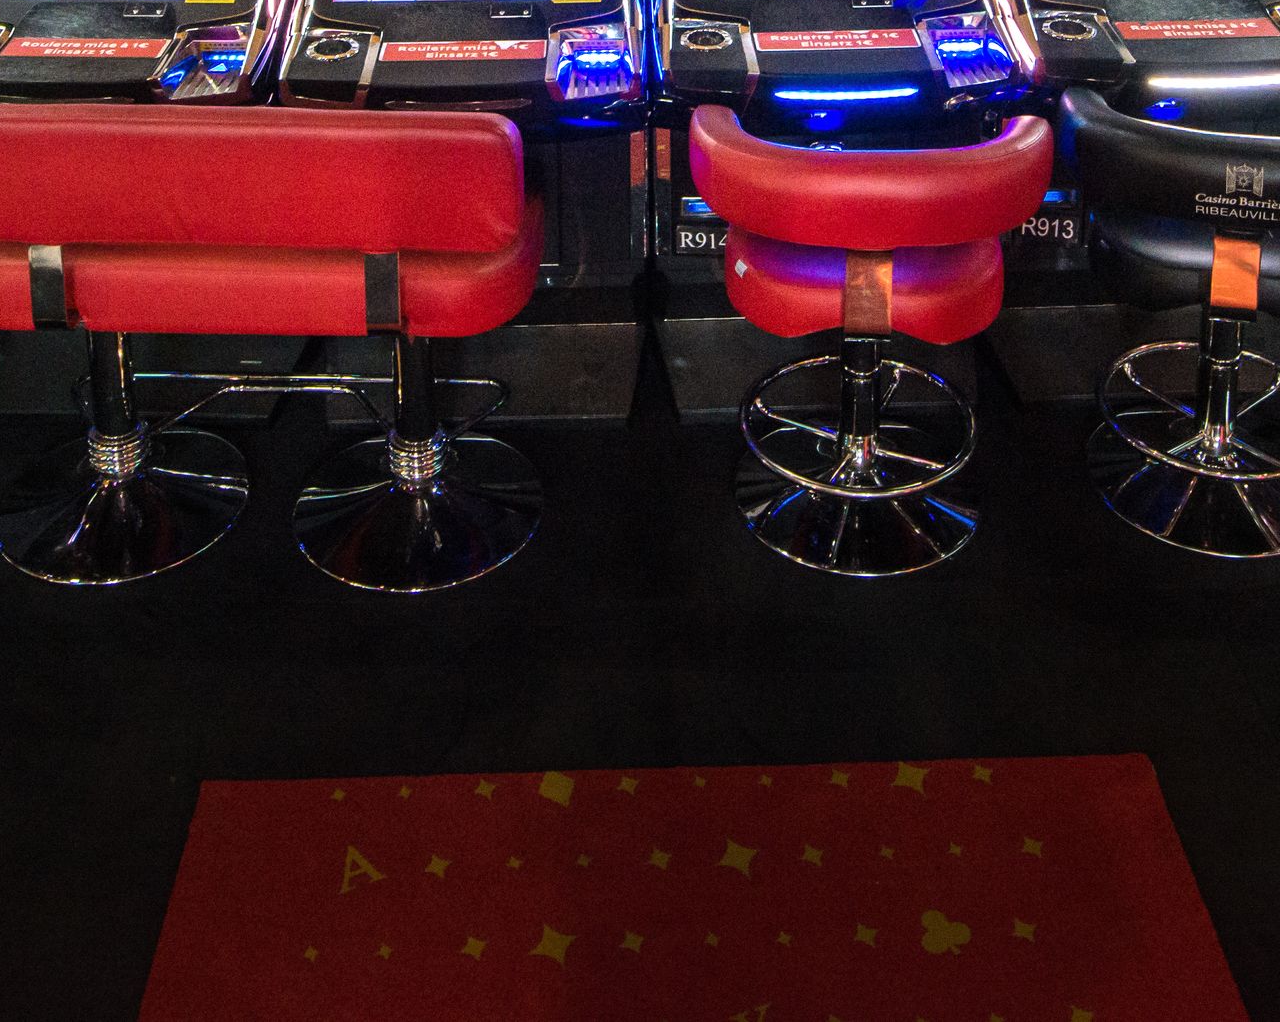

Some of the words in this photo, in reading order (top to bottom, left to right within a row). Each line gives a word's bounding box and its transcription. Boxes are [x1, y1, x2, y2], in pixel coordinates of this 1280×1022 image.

[1195, 192, 1237, 206] Casino
[1021, 217, 1074, 239] R913
[679, 230, 726, 249] R914
[339, 844, 387, 894] A
